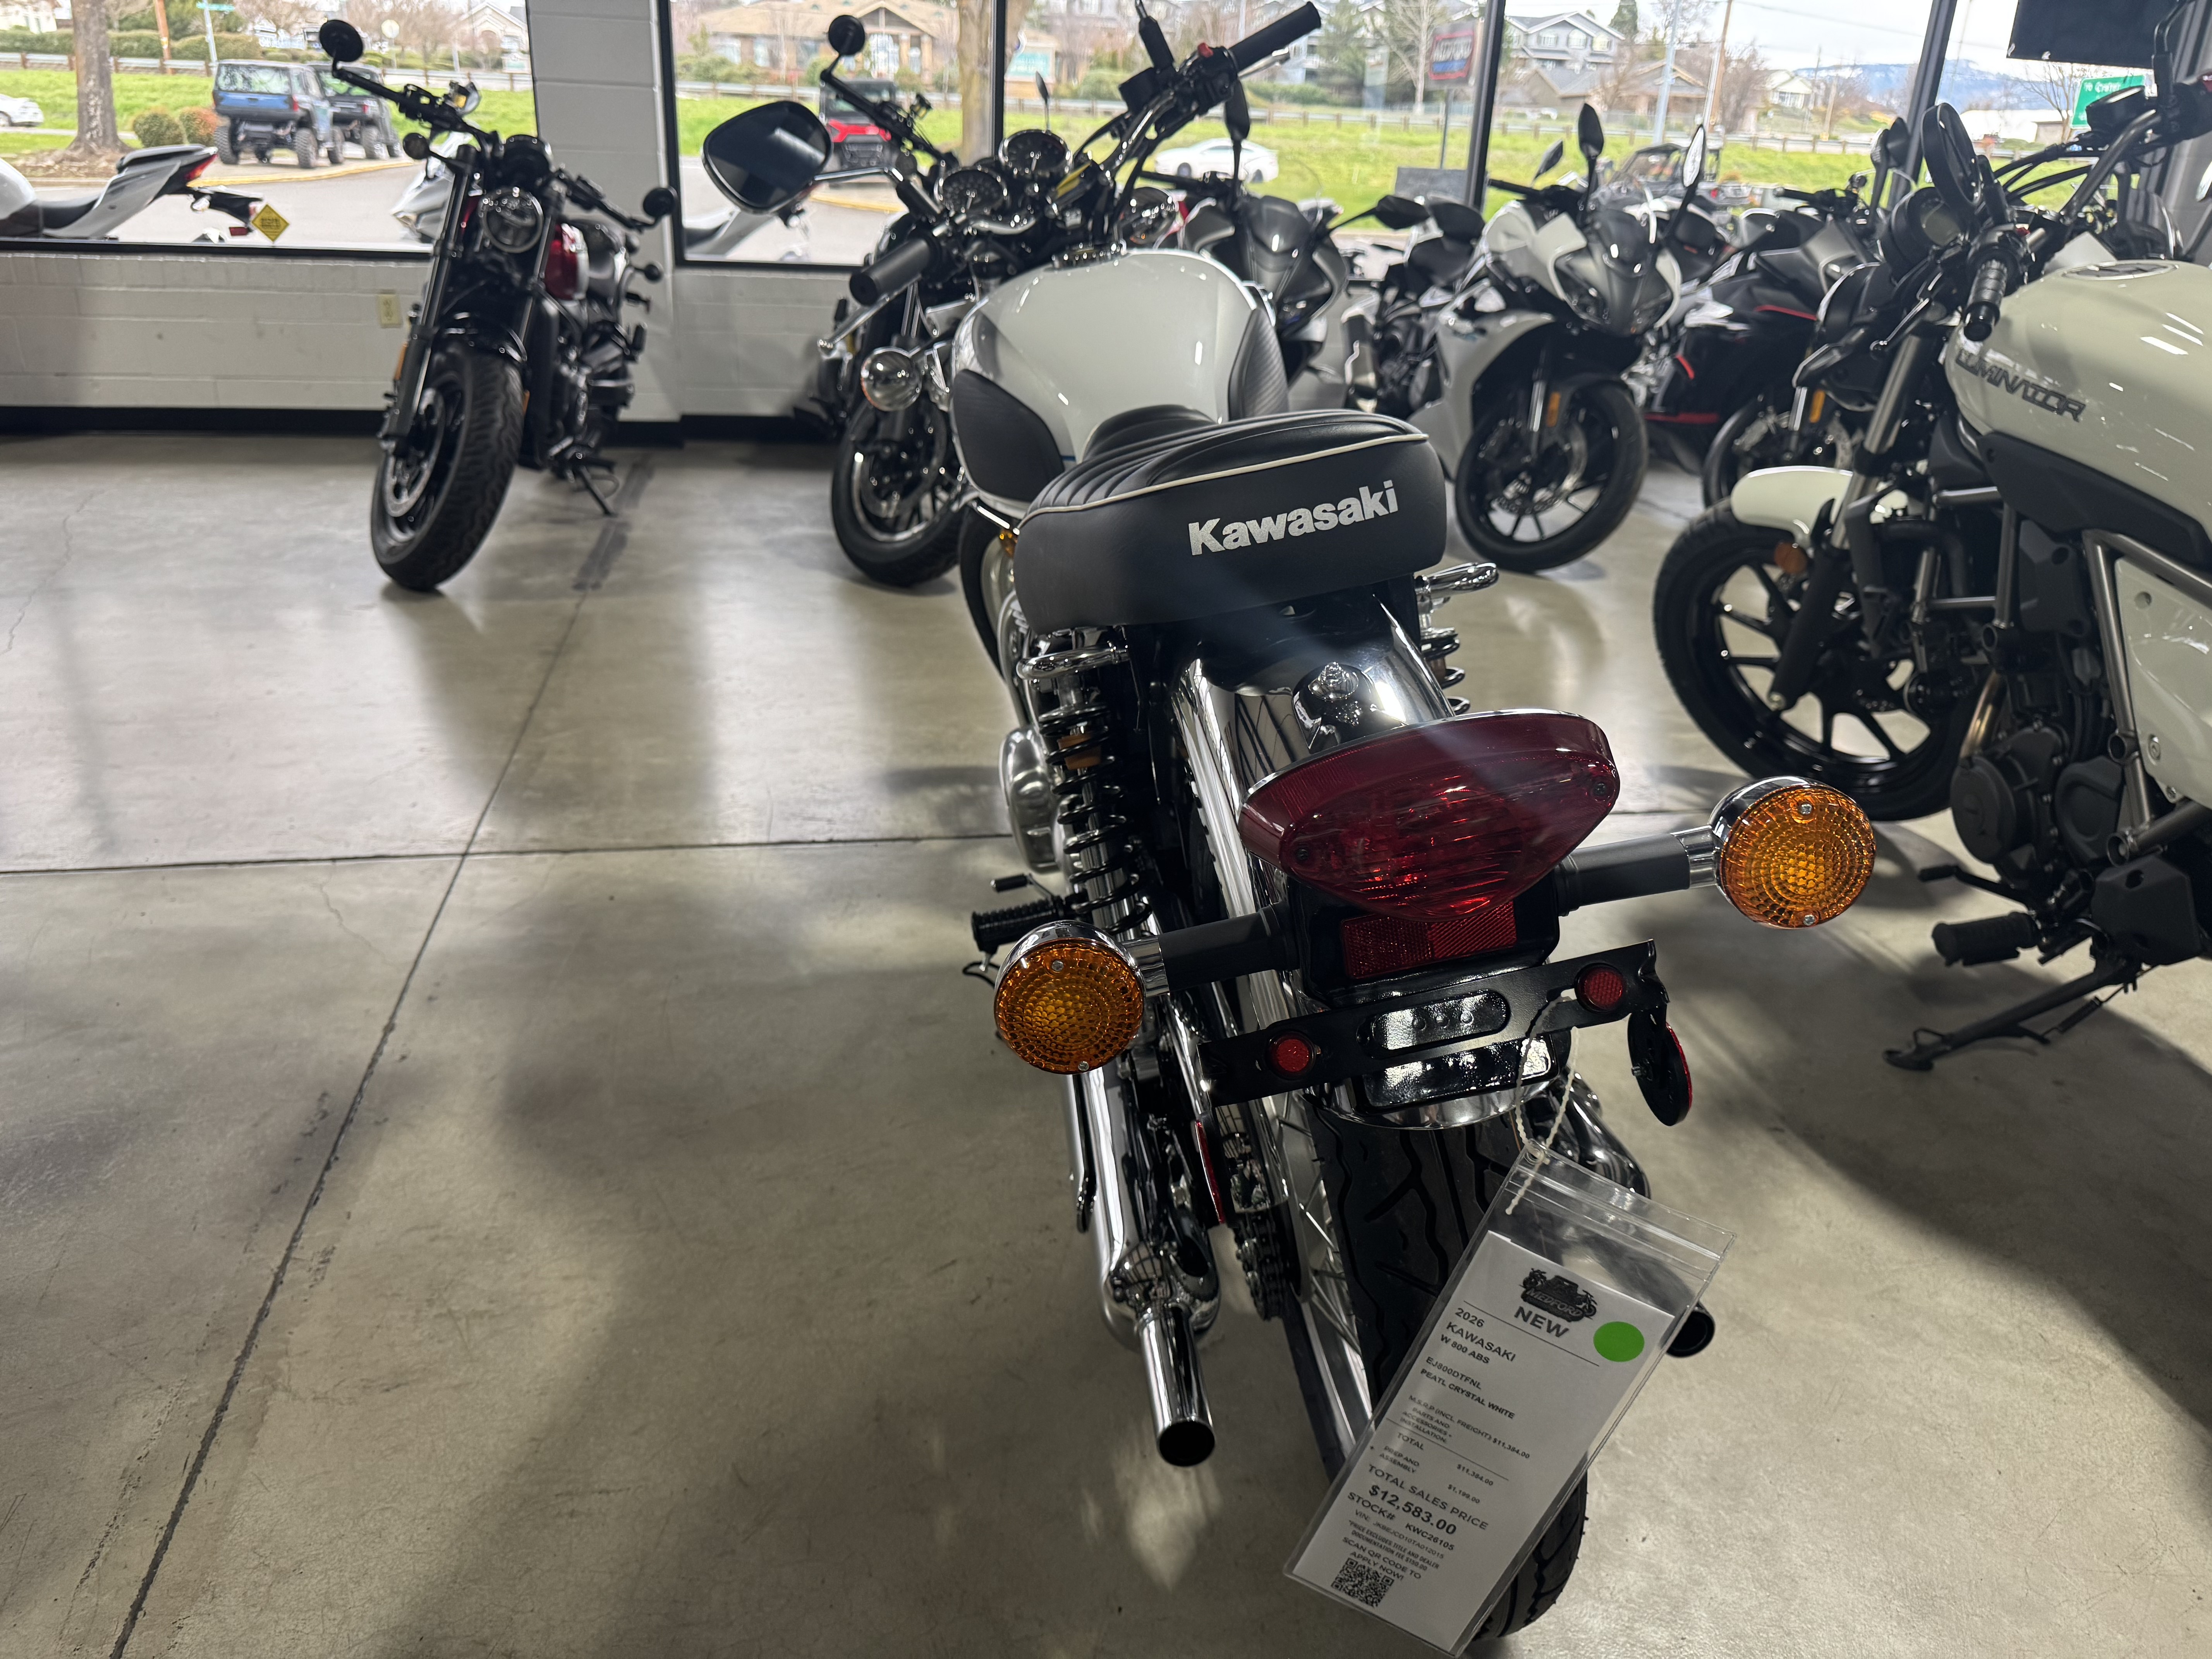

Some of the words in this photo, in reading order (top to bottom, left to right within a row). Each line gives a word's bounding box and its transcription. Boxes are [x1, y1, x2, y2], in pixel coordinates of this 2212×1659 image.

[1188, 479, 1398, 556] Kawasaki
[1455, 1307, 1485, 1328] 2026
[1526, 1288, 1583, 1317] MEDFORD
[1513, 1305, 1570, 1338] NEW
[1440, 1334, 1451, 1344] W
[1451, 1341, 1468, 1353] 800
[1468, 1350, 1490, 1364] ABS
[1446, 1321, 1516, 1362] KAWASAKI
[1425, 1356, 1482, 1390] EJ800DTFNL
[1448, 1383, 1486, 1407] CRYSTAL
[1487, 1401, 1515, 1420] WHITE
[1402, 1411, 1448, 1436] ACCESSORIES
[1412, 1407, 1435, 1422] PARTS
[1434, 1419, 1450, 1429] AND
[1383, 1445, 1404, 1458] PREP
[1403, 1456, 1420, 1467] AND
[1397, 1432, 1424, 1451] TOTAL
[1379, 1453, 1417, 1474] ASSEMBLY
[1369, 1464, 1405, 1490] TOTAL
[1408, 1485, 1448, 1510] SALES
[1449, 1506, 1489, 1530] PRICE
[1369, 1484, 1457, 1535] $12,583.00
[1347, 1492, 1396, 1520] STOCK#
[1405, 1522, 1455, 1551] KWC26105
[1342, 1537, 1367, 1553] SCAN
[1367, 1549, 1382, 1560] QR
[1382, 1556, 1408, 1573] CODE
[1409, 1569, 1422, 1579] TO
[1351, 1529, 1395, 1555] DOCUMENTATION
[1395, 1551, 1405, 1561] FEE
[1365, 1528, 1393, 1546] EXCLUDES
[1392, 1542, 1408, 1554] TITLE
[1407, 1550, 1420, 1559] AND
[1419, 1556, 1440, 1570] DEALER
[1349, 1551, 1379, 1567] APPLY
[1379, 1564, 1404, 1581] NOW!
